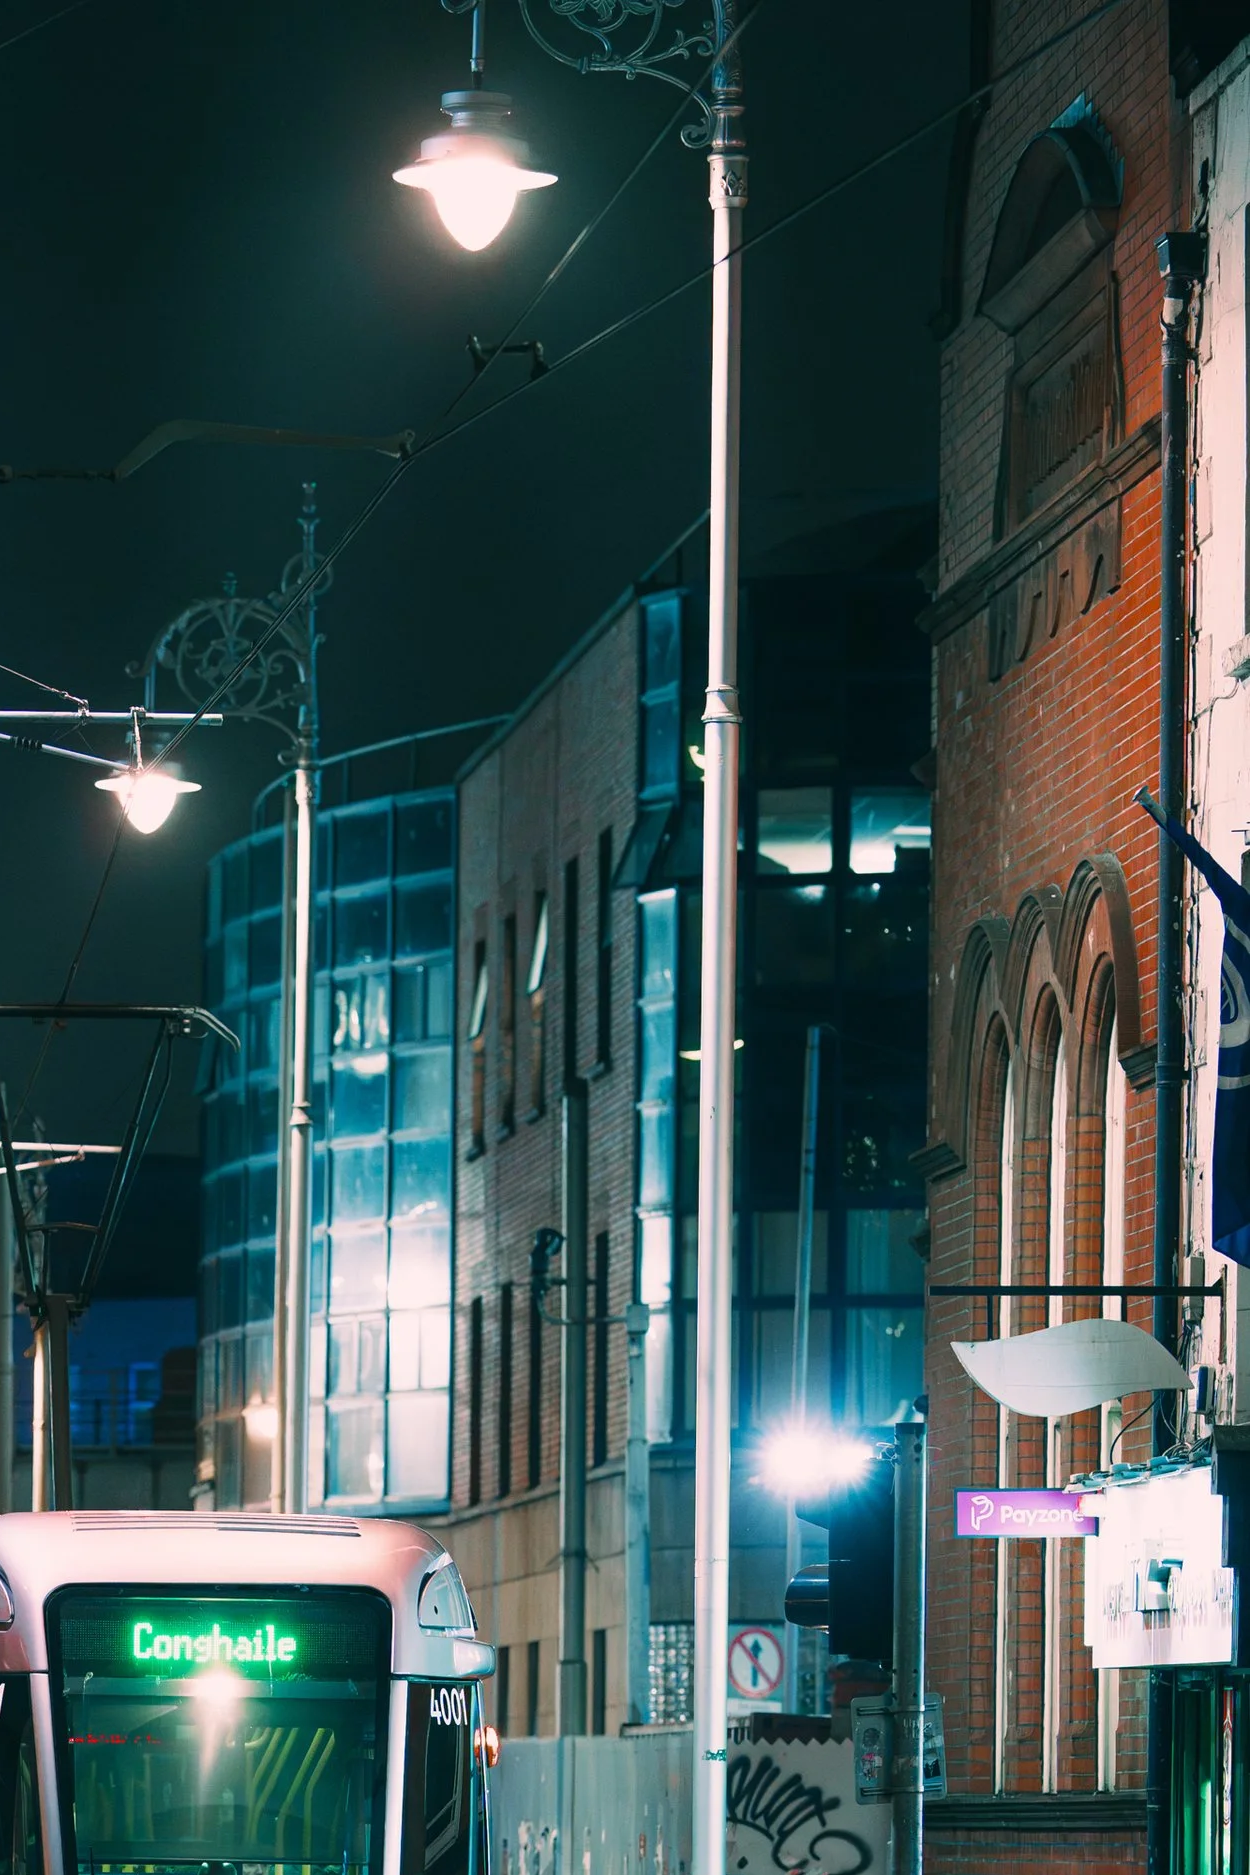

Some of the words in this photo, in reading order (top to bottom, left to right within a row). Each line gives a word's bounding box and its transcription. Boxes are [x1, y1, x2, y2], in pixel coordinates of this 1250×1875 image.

[1000, 1505, 1084, 1527] Payzone
[133, 1622, 297, 1663] Conghaile
[430, 1687, 468, 1725] 4001
